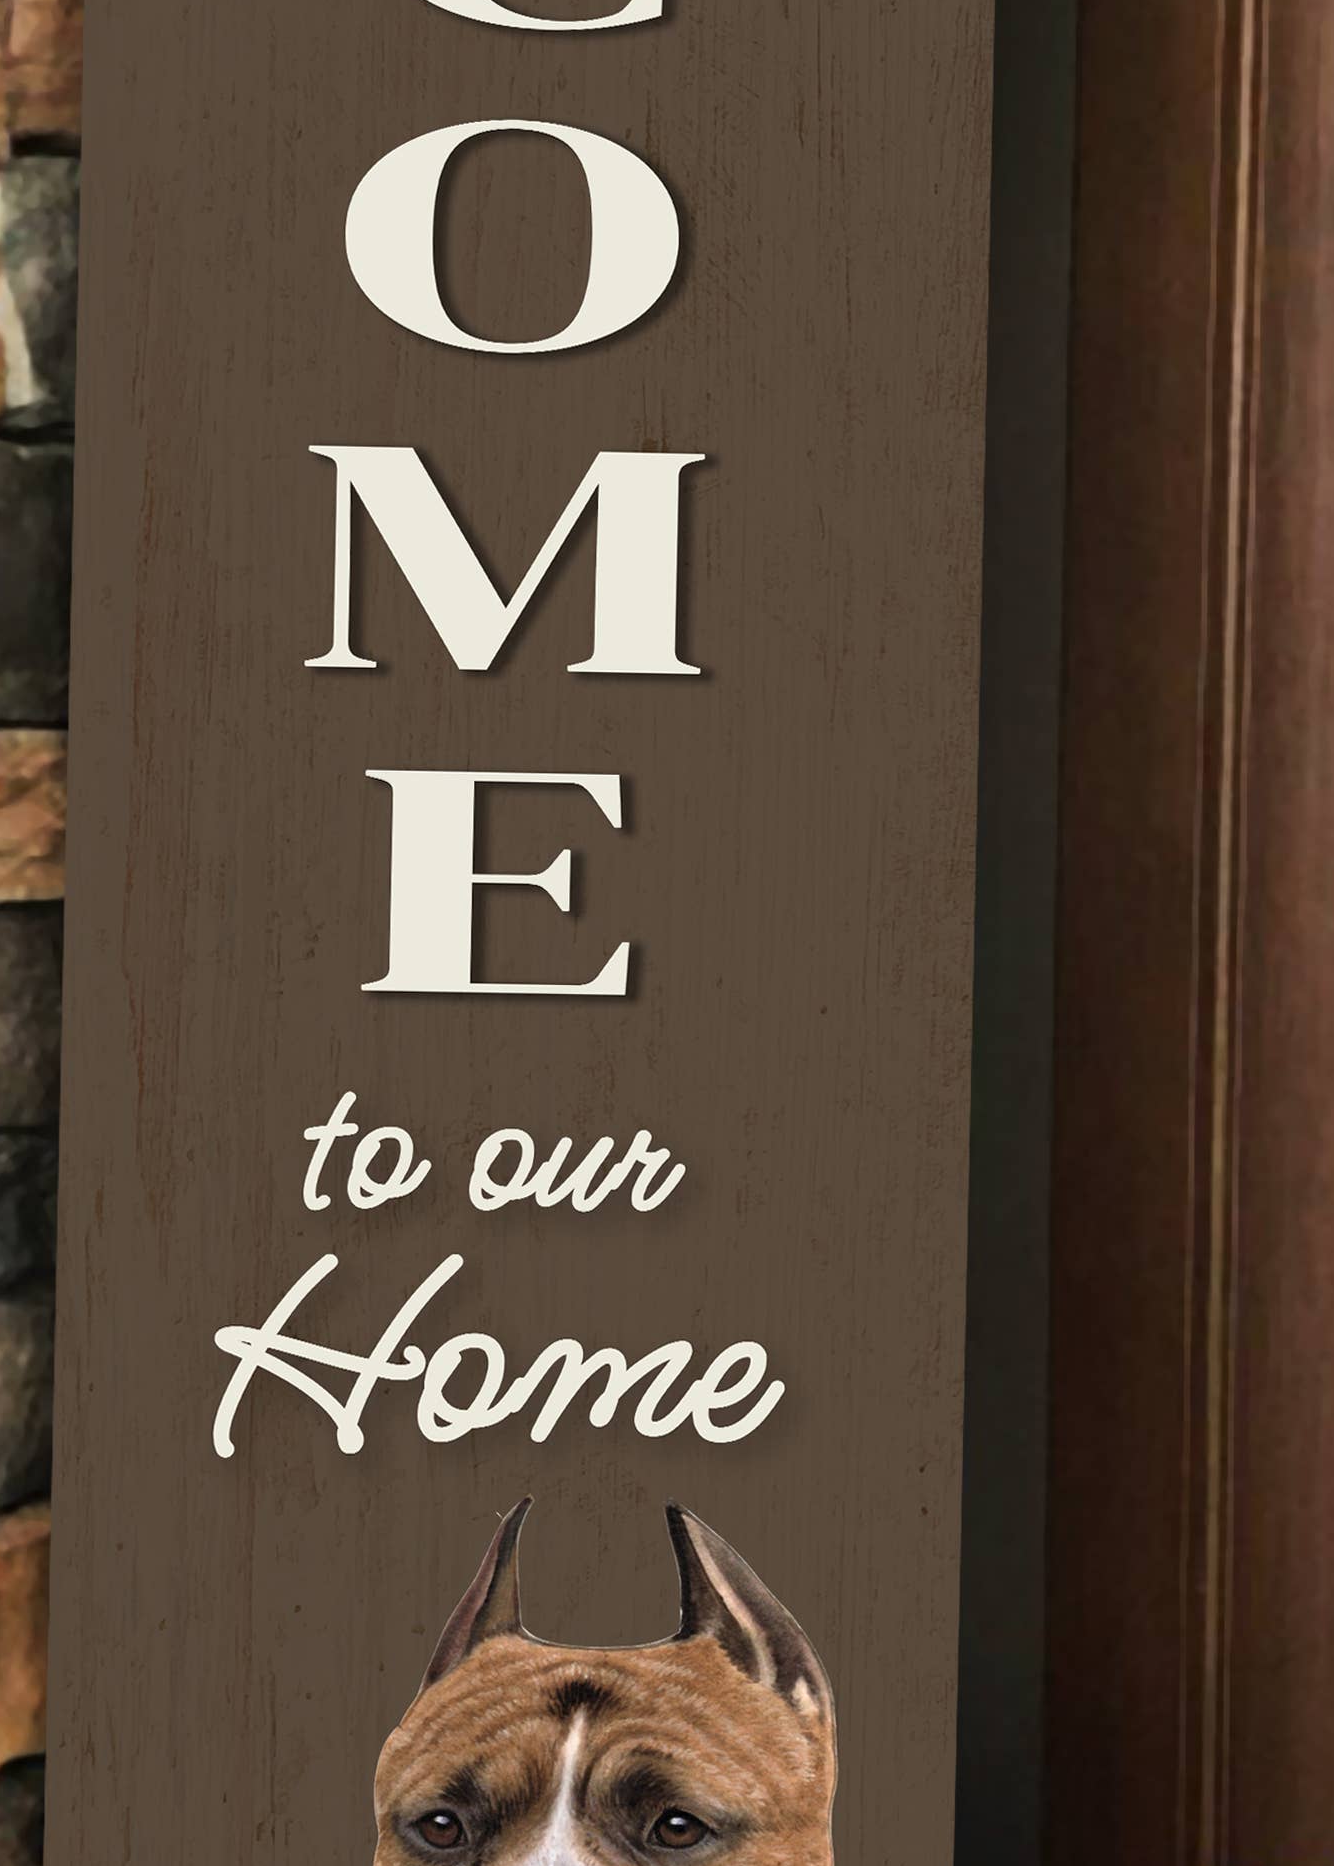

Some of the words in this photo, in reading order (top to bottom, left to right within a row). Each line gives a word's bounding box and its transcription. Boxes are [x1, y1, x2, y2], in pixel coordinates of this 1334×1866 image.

[302, 1090, 433, 1212] to
[467, 1127, 687, 1214] our
[212, 1252, 786, 1460] Home
